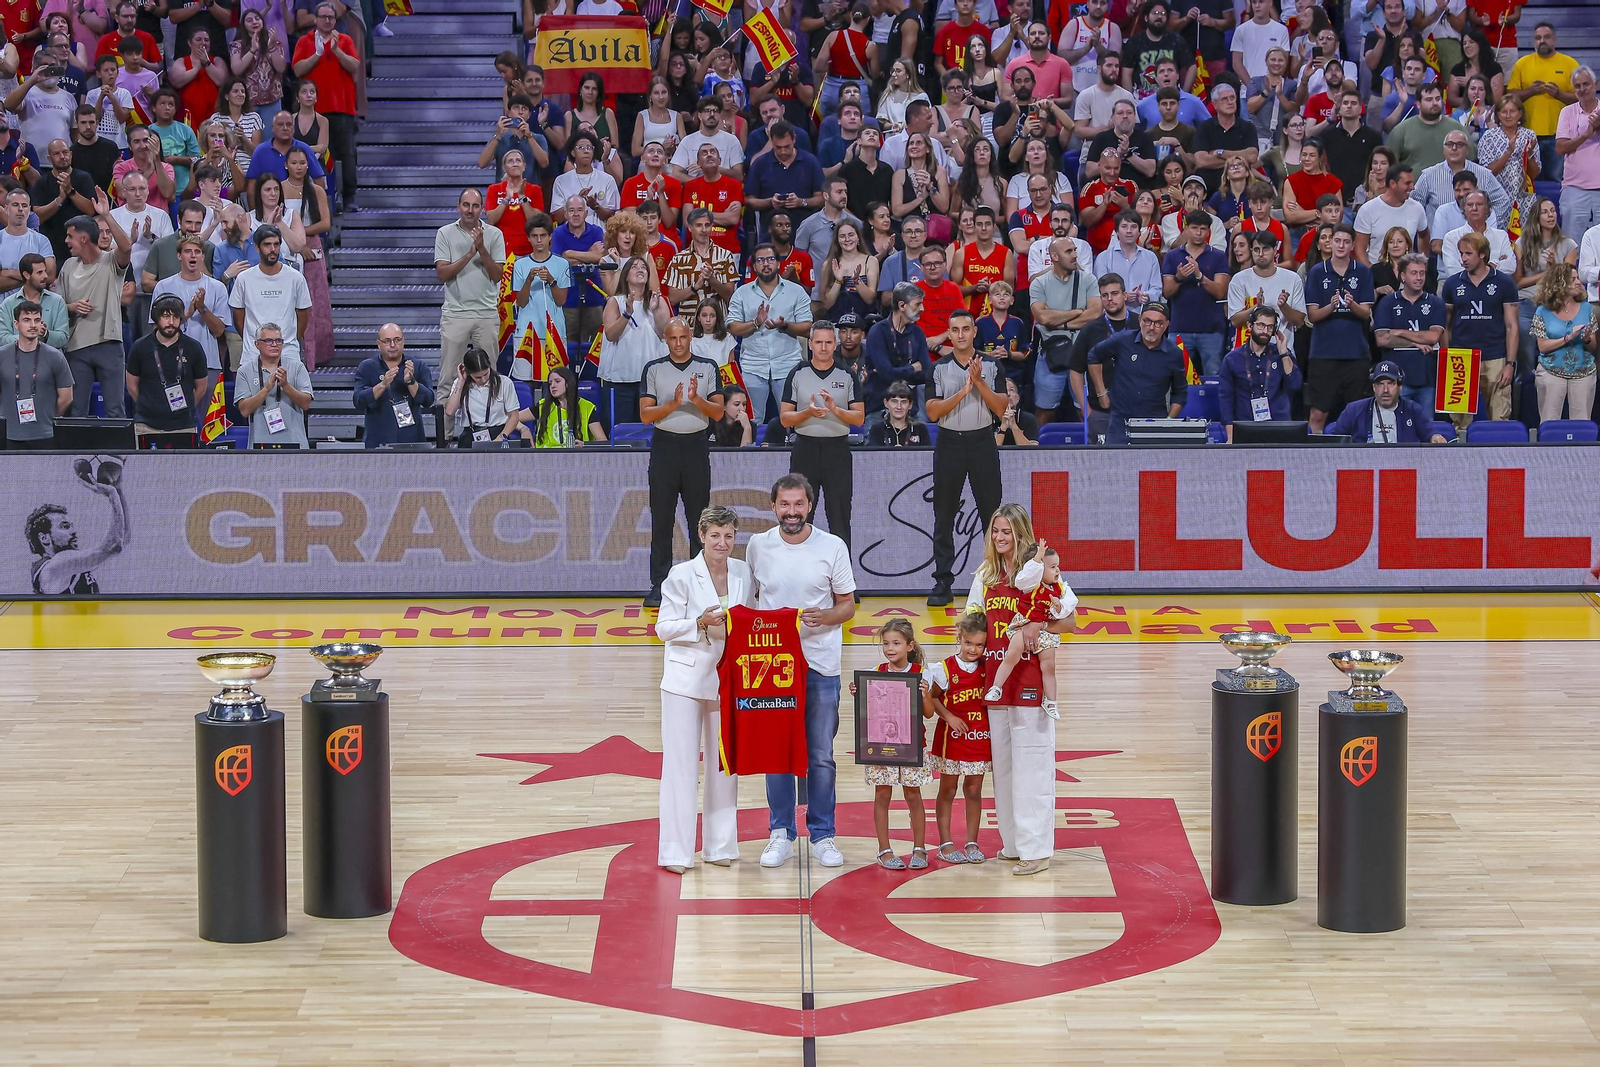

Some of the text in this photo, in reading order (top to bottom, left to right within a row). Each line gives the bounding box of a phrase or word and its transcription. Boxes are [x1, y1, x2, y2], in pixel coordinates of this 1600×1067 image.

[548, 30, 642, 64] Ávila
[752, 20, 781, 63] ESPAÑA
[968, 263, 1000, 275] ESPAÑA
[1447, 354, 1466, 406] ESPAÑA
[1031, 469, 1591, 571] LLULL
[404, 604, 659, 619] Movi
[167, 623, 657, 640] Comunid
[993, 621, 1008, 639] 17
[748, 633, 782, 647] LLULL
[736, 653, 795, 689] 173
[749, 697, 796, 710] CaixaBank
[967, 711, 982, 721] 173
